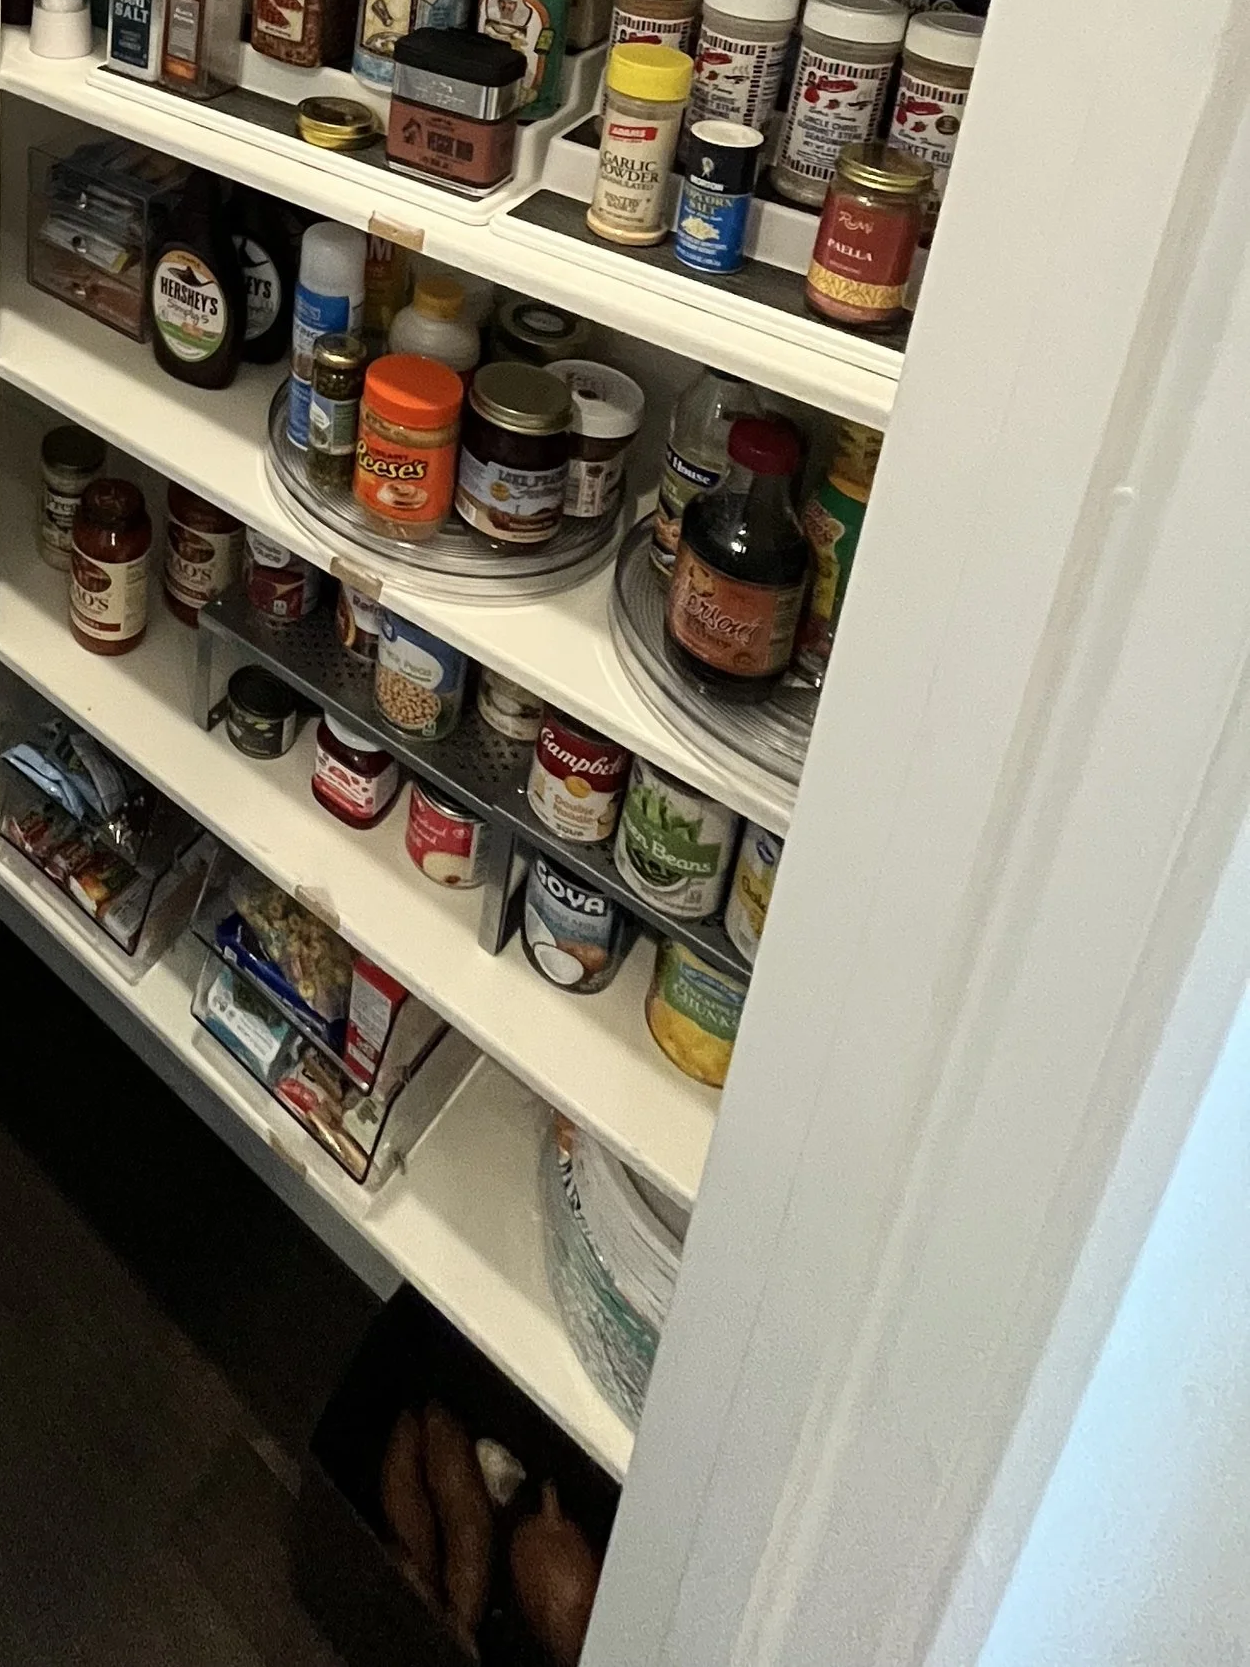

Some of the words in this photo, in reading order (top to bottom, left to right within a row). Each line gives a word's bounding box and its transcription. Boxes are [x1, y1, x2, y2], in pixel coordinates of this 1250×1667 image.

[114, 1, 149, 24] SALT
[803, 114, 830, 129] UNCLE
[602, 162, 659, 183] POWDER
[603, 150, 657, 172] GARLIC
[827, 237, 873, 262] PAELLA
[160, 275, 219, 316] HERSHEY'S
[357, 439, 427, 480] Reese's
[672, 456, 711, 485] House
[652, 839, 712, 873] Beans
[535, 859, 605, 915] GOYA
